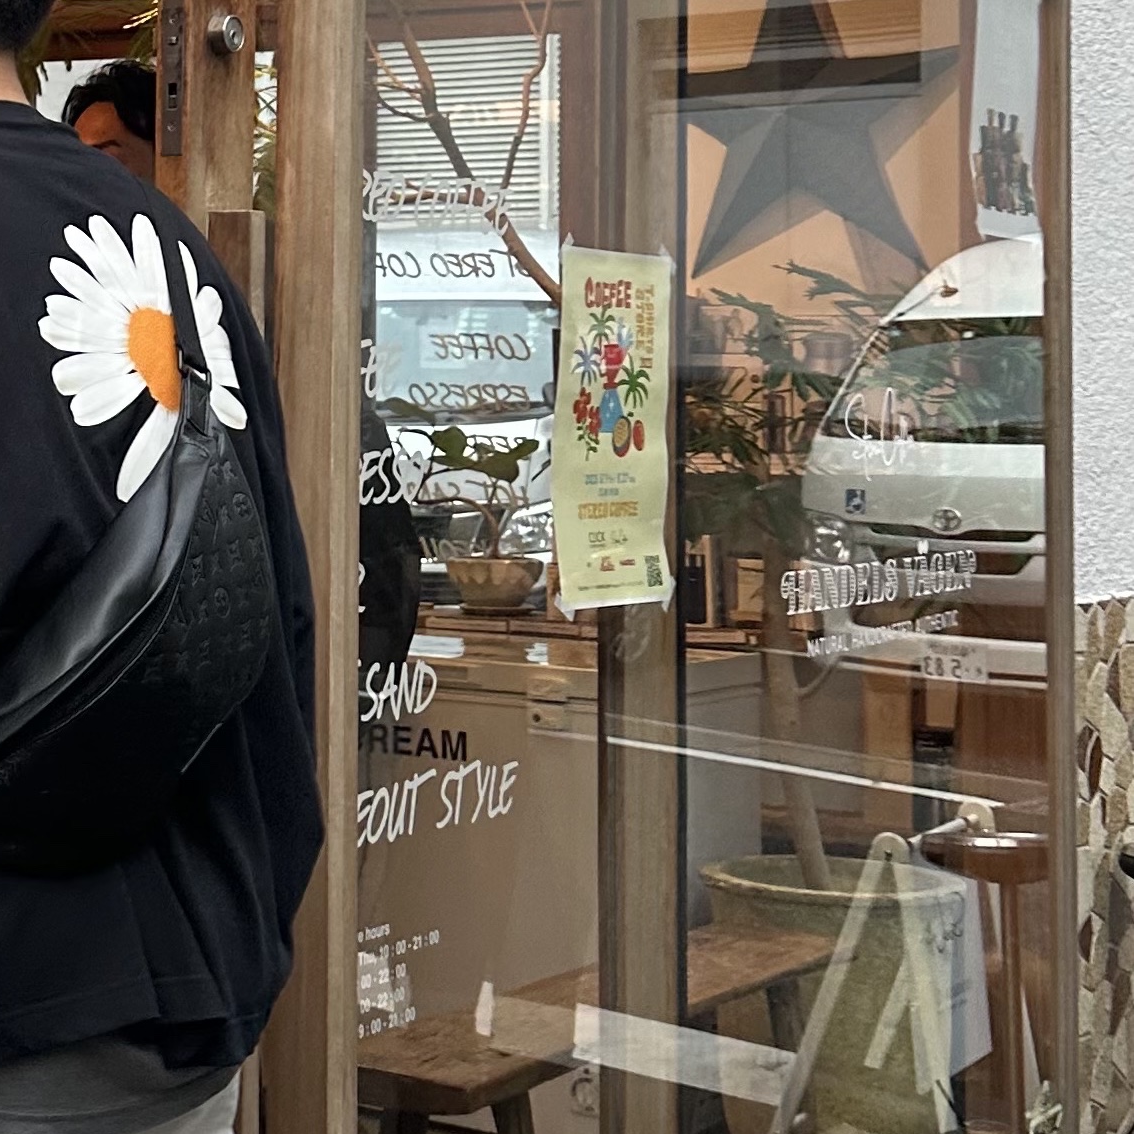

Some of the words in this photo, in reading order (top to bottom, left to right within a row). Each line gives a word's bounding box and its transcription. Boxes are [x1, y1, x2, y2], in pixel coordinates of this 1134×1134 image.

[585, 276, 632, 309] COFFEE
[360, 659, 437, 722] SAND
[357, 723, 467, 762] REAM
[436, 760, 519, 829] STYLE
